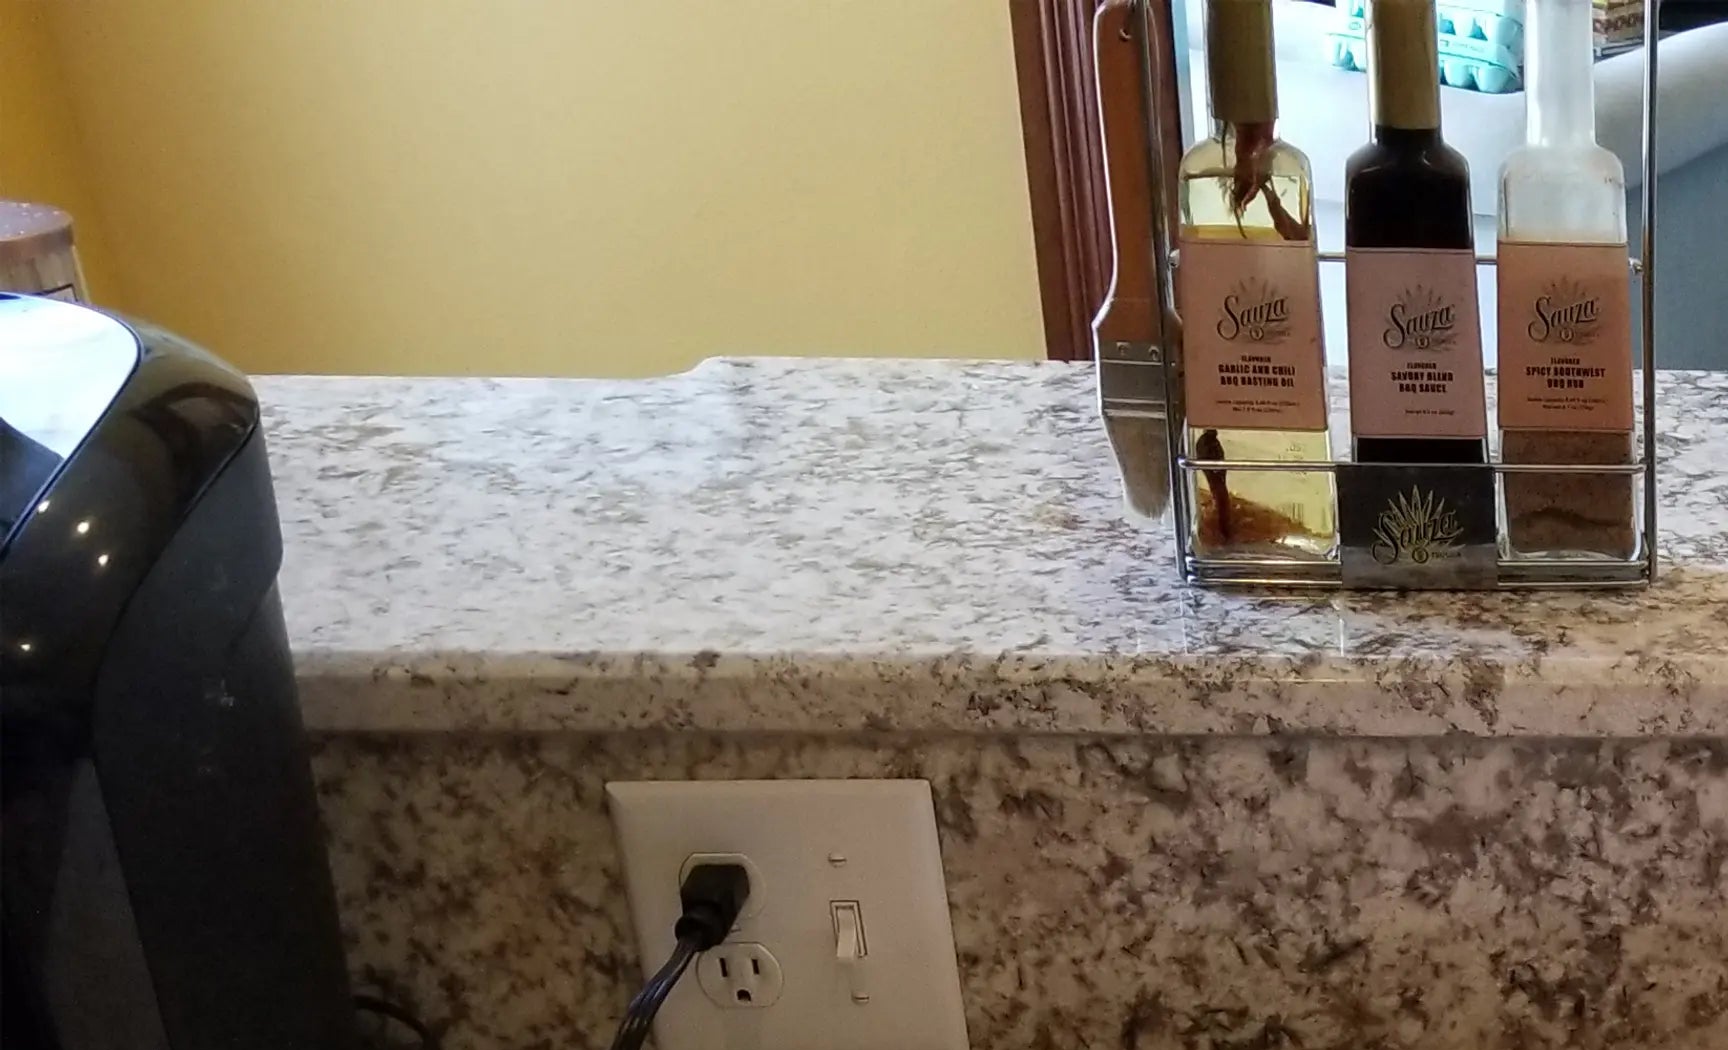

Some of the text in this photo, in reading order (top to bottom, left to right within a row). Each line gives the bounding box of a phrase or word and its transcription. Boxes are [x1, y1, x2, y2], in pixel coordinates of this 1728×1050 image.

[1217, 295, 1288, 341] Sauza
[1528, 296, 1599, 342] Sauza
[1383, 304, 1455, 349] Sauza
[1218, 364, 1295, 376] GARLIC AND CHILI
[1526, 366, 1606, 377] SPICY SOUTHWEST
[1221, 376, 1294, 387] BBQ BASTING OIL
[1391, 371, 1424, 381] SAVORY
[1400, 383, 1447, 393] BBQ SAUCE
[1547, 378, 1565, 388] BBQ
[1371, 510, 1459, 565] Sauza
